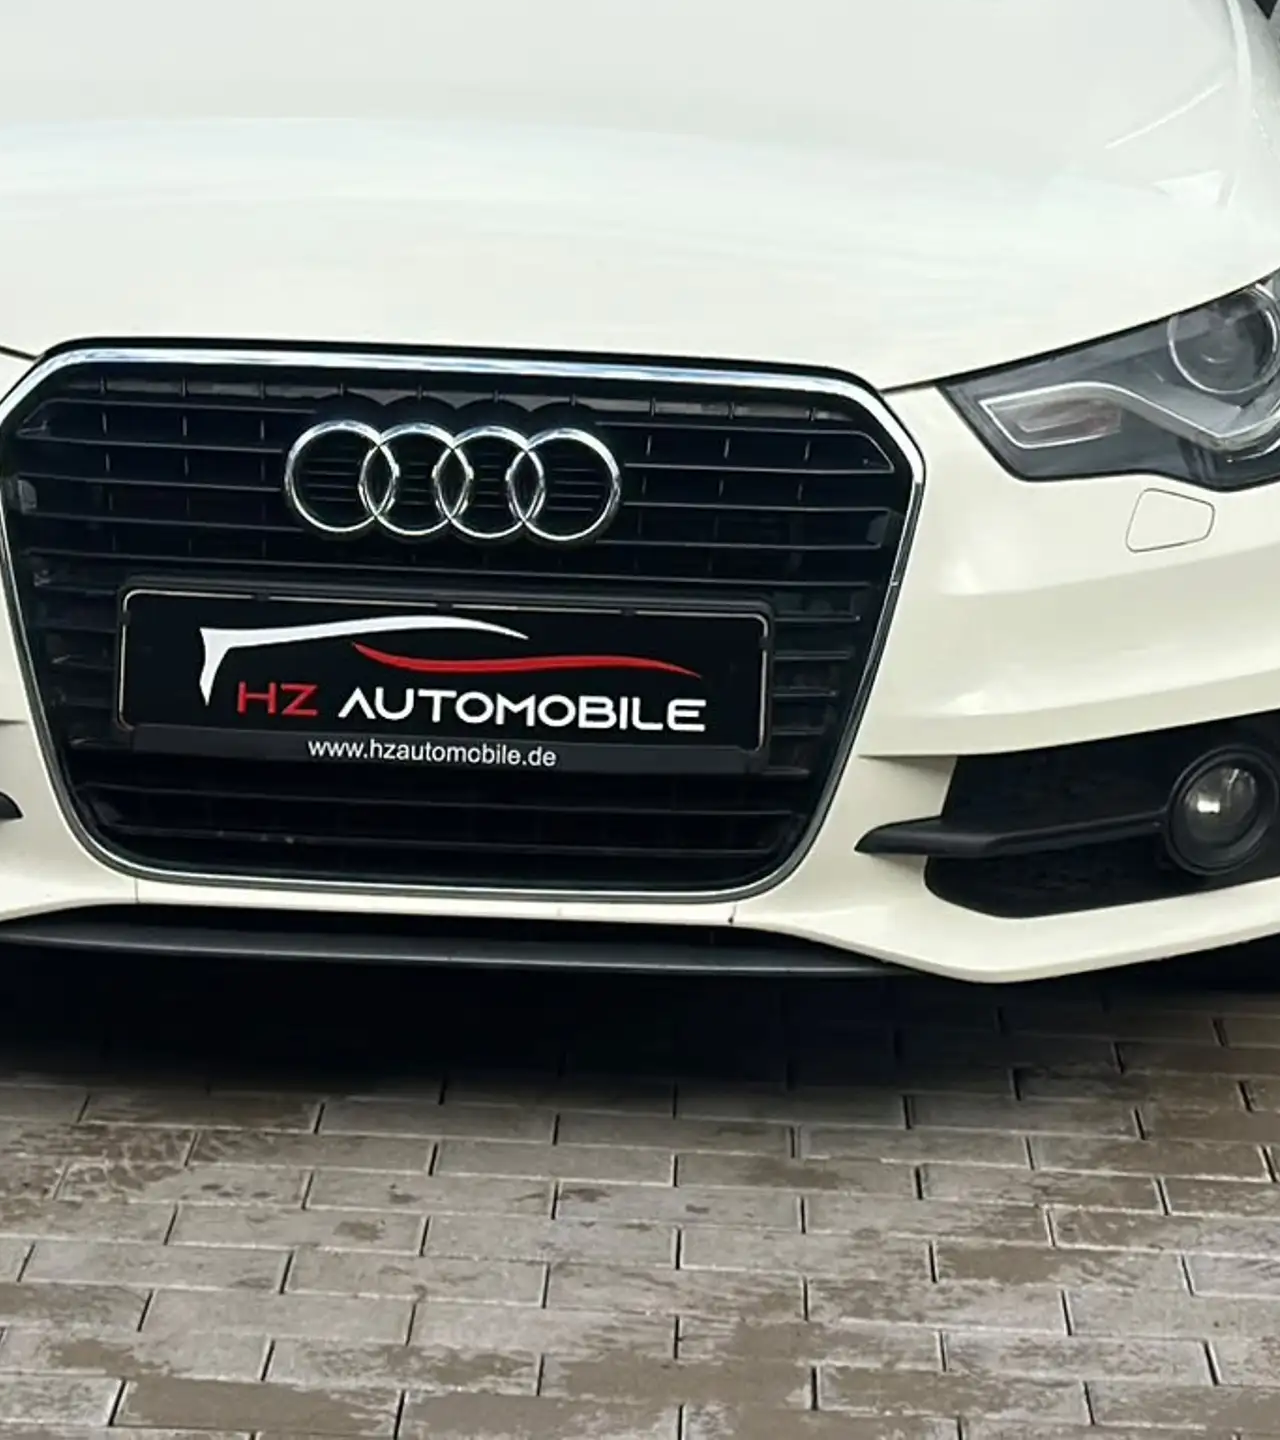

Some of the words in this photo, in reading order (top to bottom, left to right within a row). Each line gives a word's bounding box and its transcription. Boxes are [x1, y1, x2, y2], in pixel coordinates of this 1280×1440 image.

[236, 681, 319, 718] HZ
[337, 686, 708, 733] AUTOMOBILE
[307, 738, 558, 768] www.hzautomobile.de
